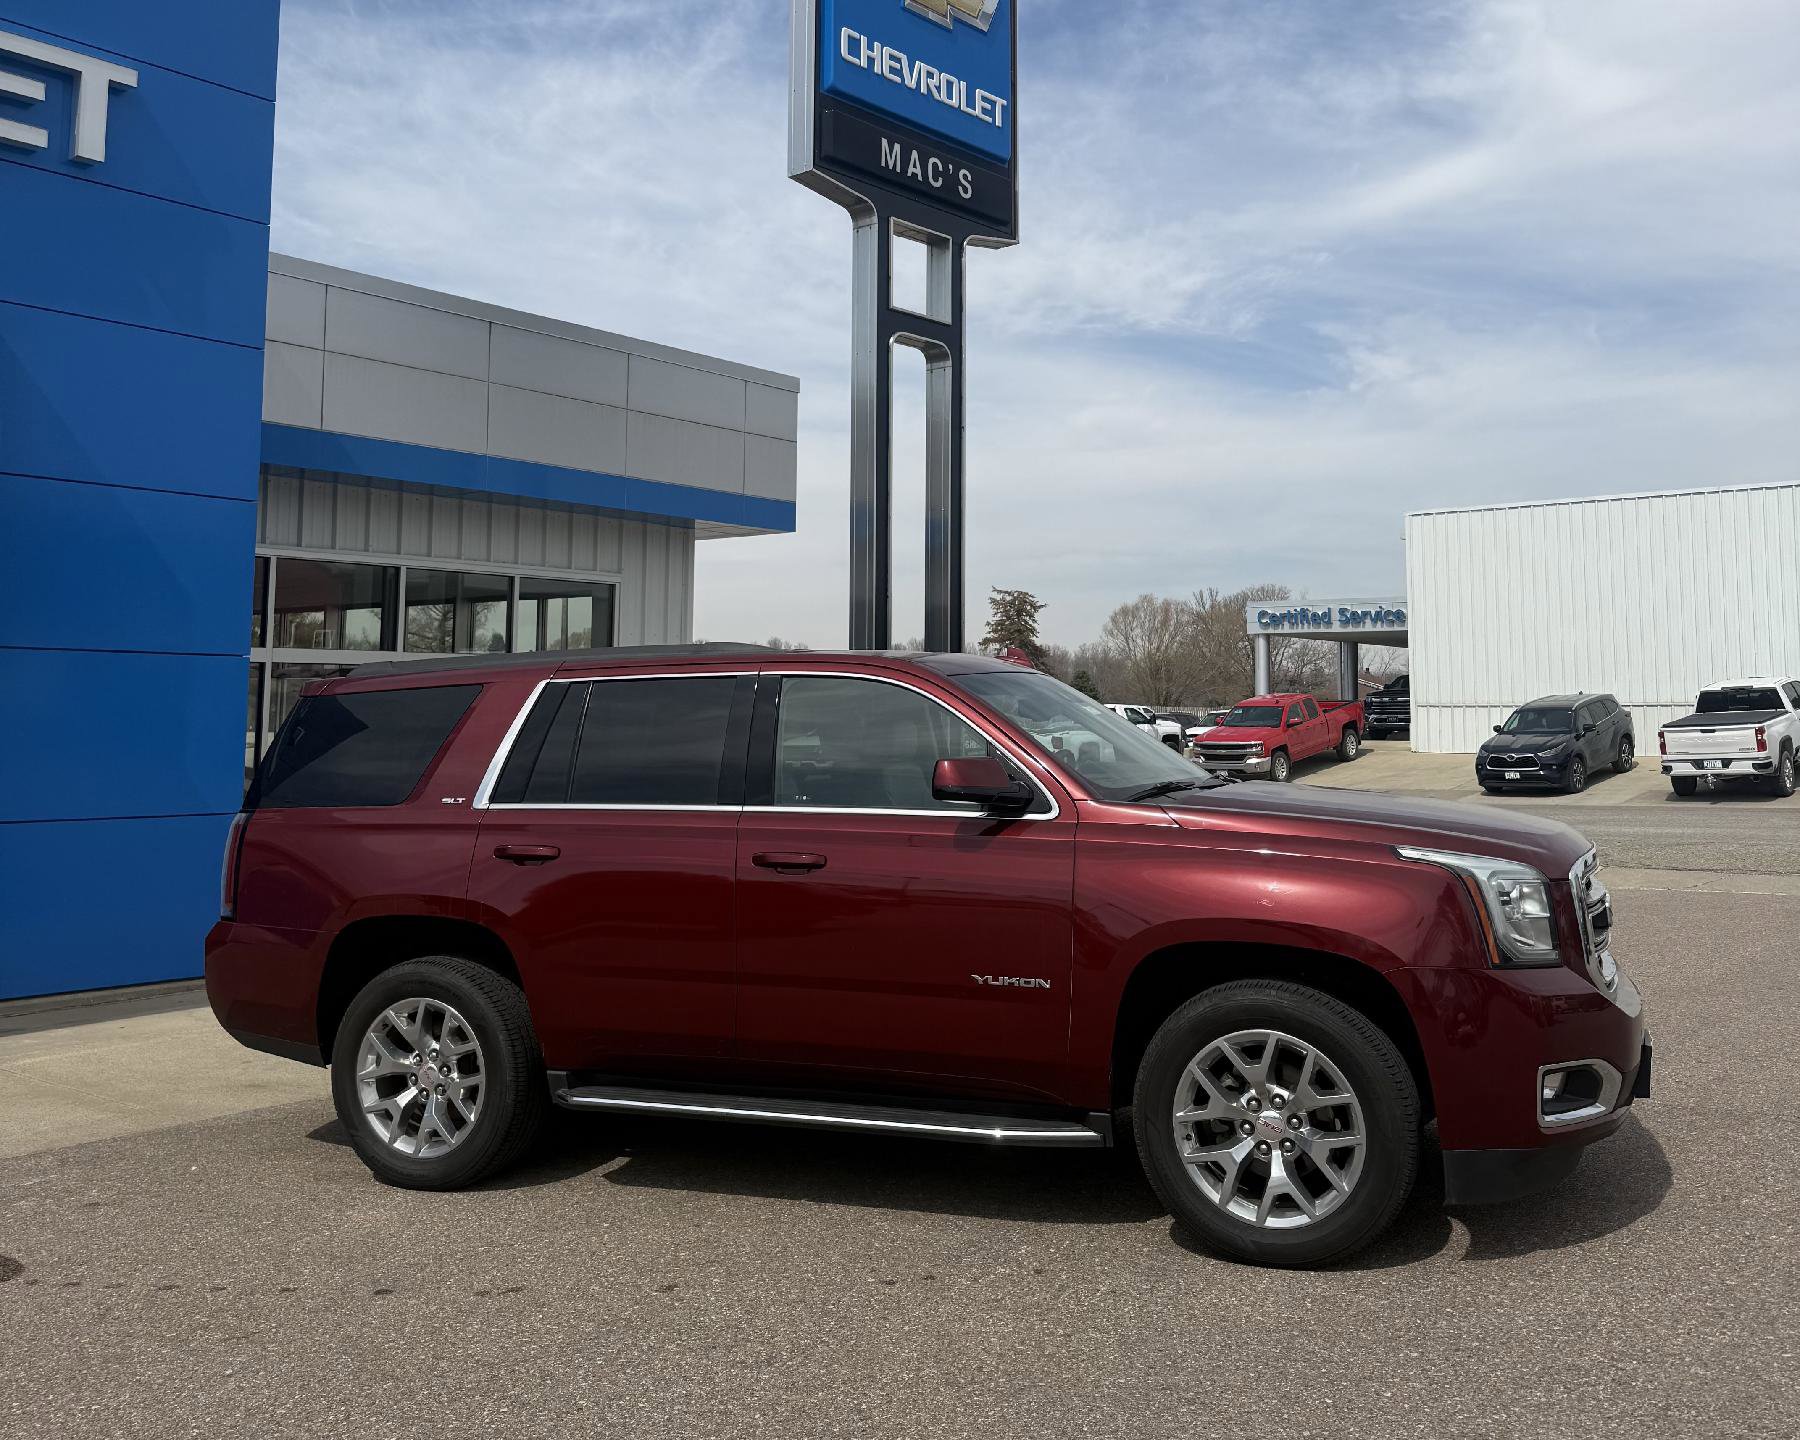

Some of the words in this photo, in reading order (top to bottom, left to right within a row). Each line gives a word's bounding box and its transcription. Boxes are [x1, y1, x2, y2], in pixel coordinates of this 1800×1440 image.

[840, 27, 1008, 127] CHEVROLET
[881, 137, 973, 200] MAC'S
[1257, 607, 1333, 626] Certified
[1338, 605, 1407, 625] Service
[970, 974, 1051, 989] YUKON
